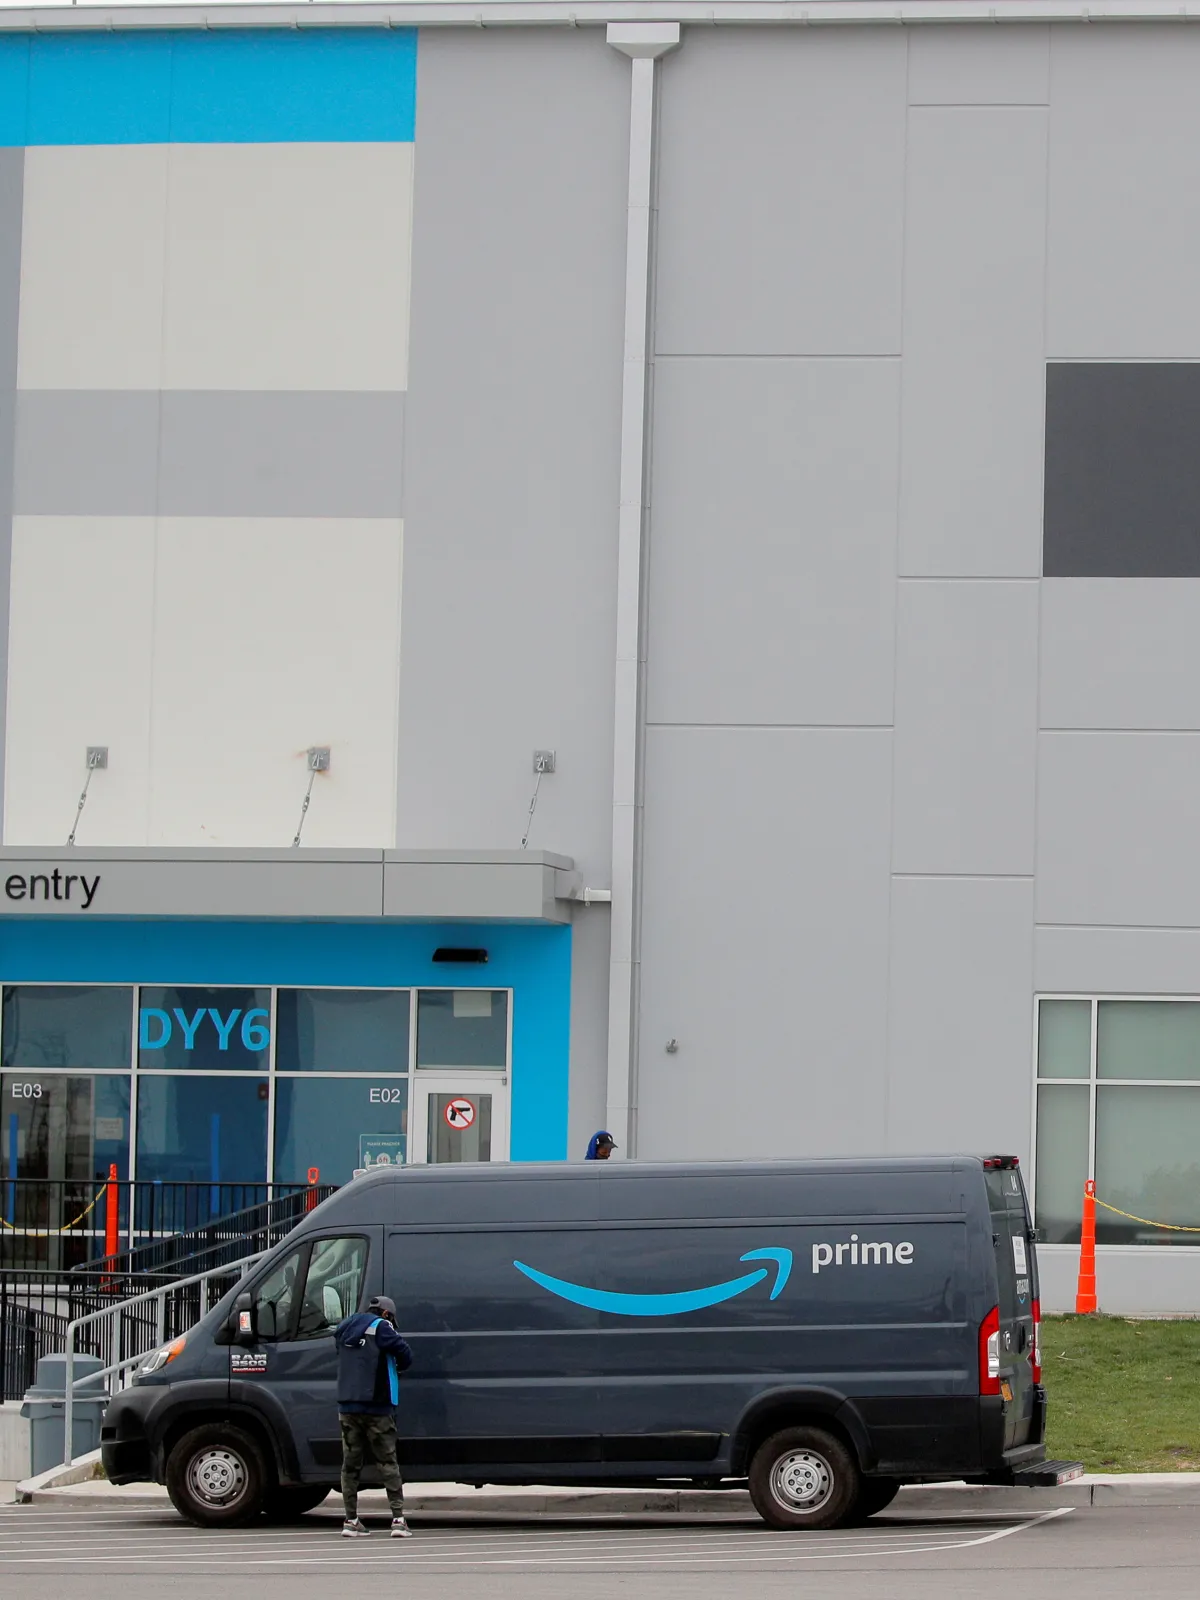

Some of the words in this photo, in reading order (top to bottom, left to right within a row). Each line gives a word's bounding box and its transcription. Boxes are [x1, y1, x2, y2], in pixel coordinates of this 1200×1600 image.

[5, 868, 101, 910] entry
[139, 1008, 270, 1051] DYY6
[12, 1083, 43, 1098] E03
[369, 1088, 401, 1103] E02
[812, 1234, 914, 1274] prime
